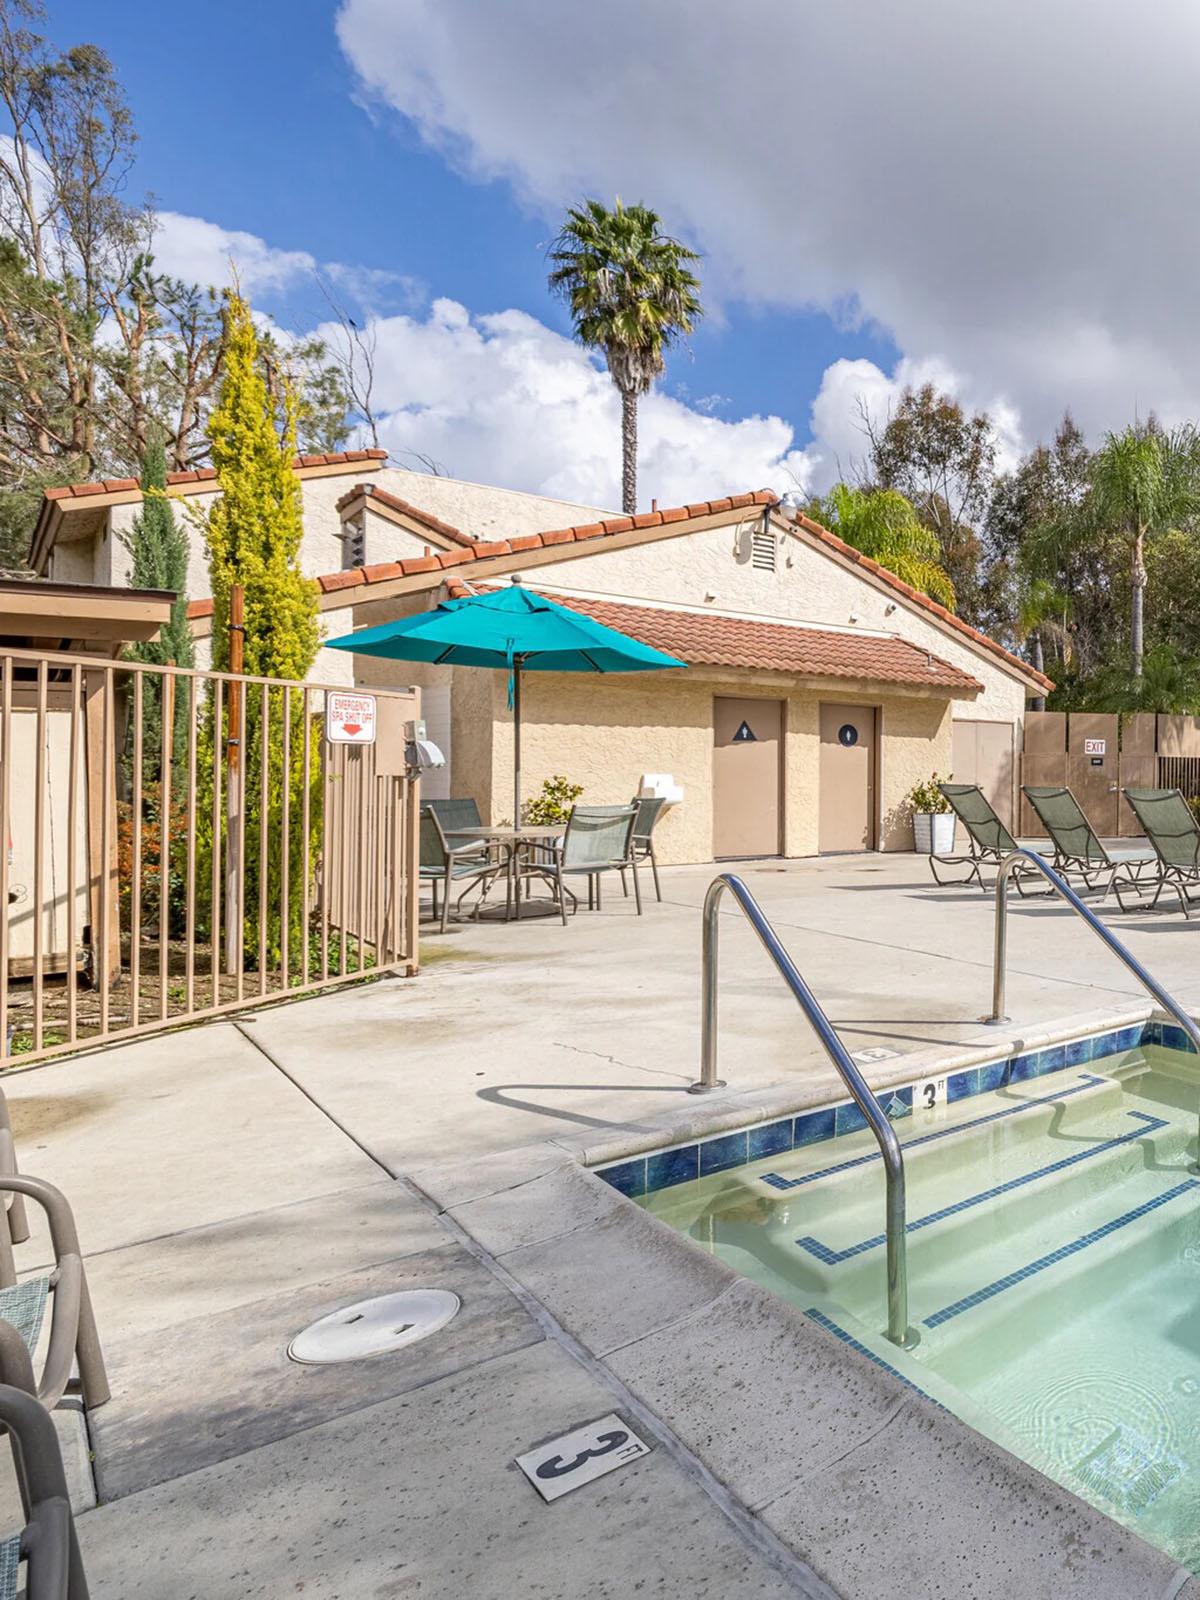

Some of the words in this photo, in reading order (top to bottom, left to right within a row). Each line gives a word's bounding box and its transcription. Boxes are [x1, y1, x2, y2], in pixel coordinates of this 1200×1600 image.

[334, 699, 370, 711] EMERGENCY
[331, 711, 343, 722] SPA
[345, 712, 360, 722] SHUT
[361, 713, 373, 723] OFF
[1086, 741, 1104, 753] EXIT
[923, 1083, 936, 1109] 3
[937, 1080, 945, 1090] FT
[536, 1430, 629, 1479] 3
[616, 1444, 644, 1460] FT
